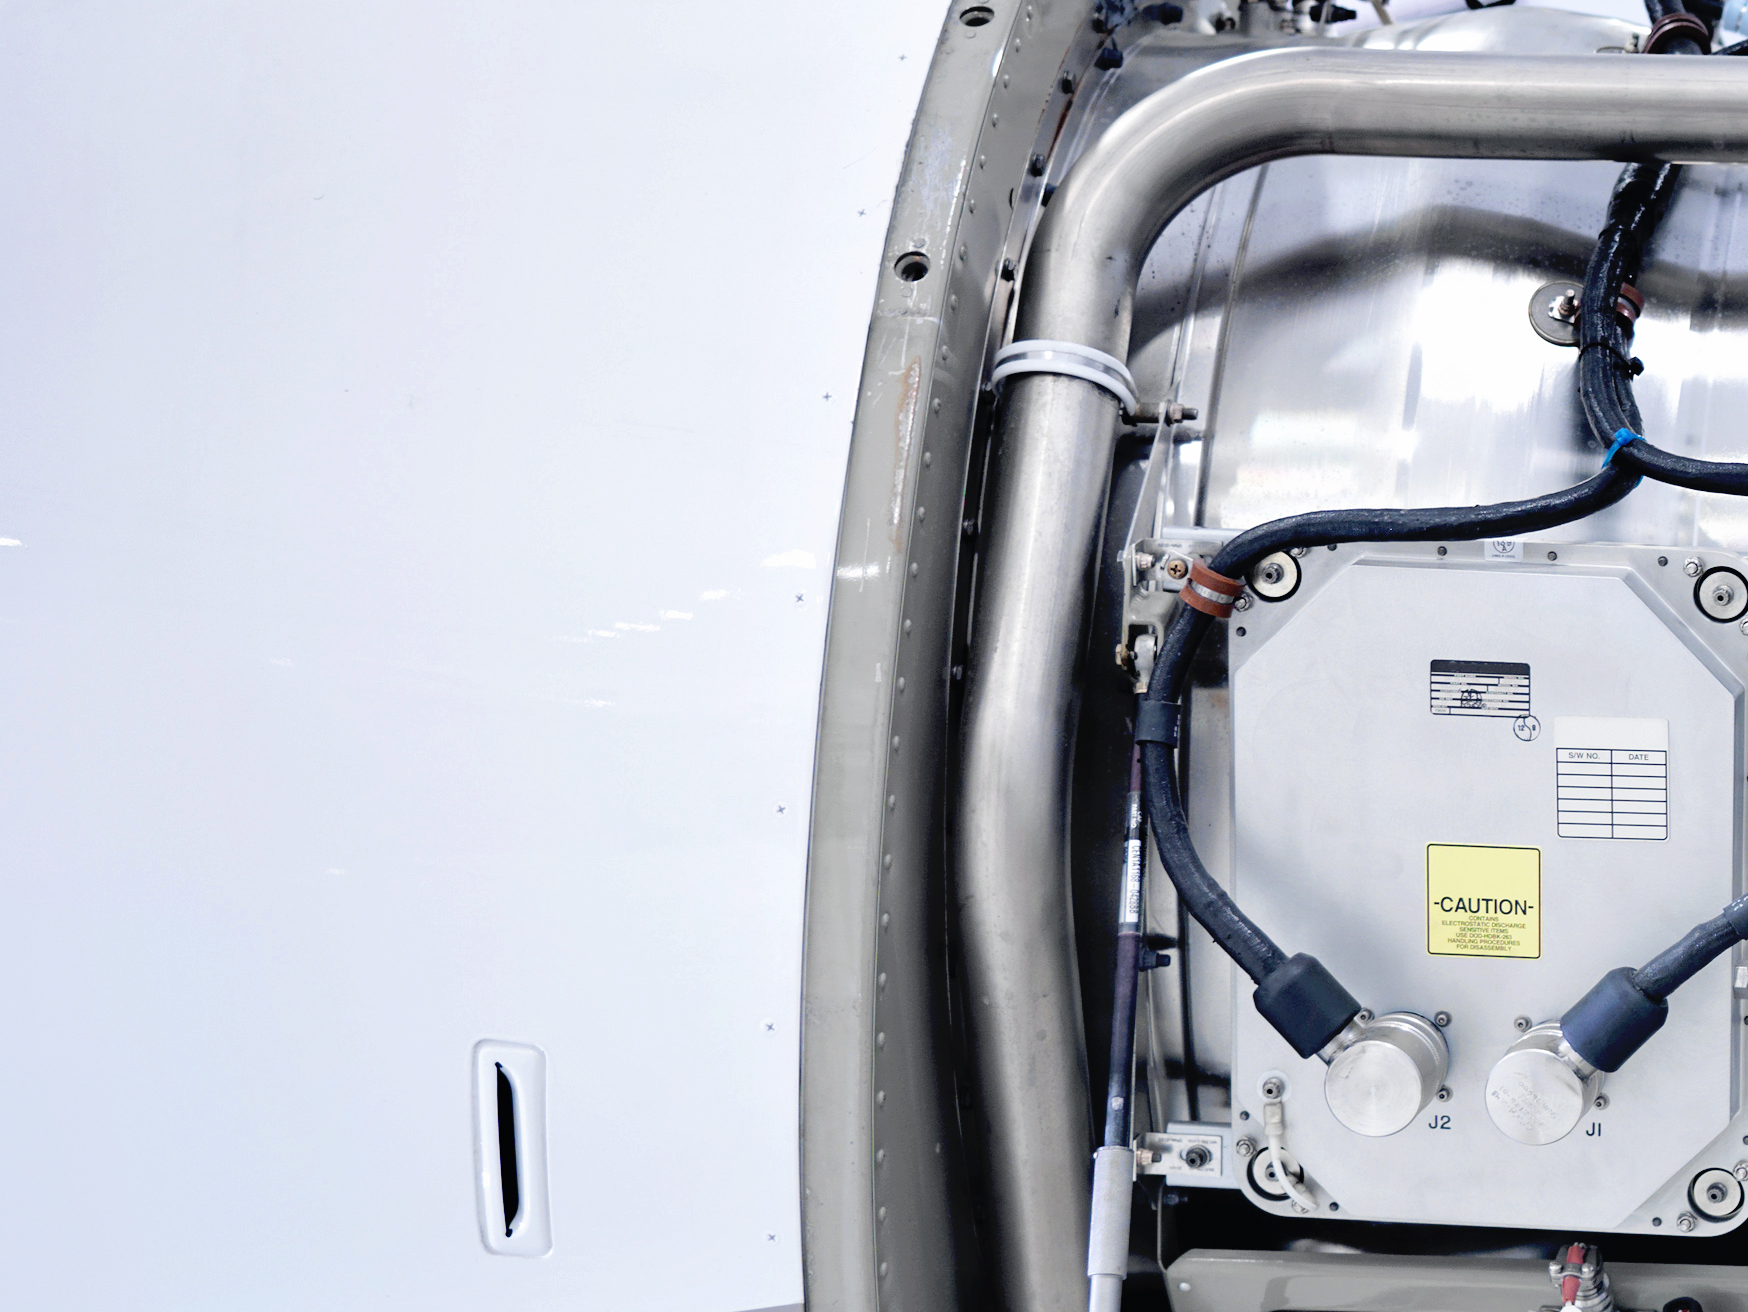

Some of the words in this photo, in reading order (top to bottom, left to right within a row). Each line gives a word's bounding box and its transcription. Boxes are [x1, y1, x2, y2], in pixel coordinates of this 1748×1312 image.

[1568, 751, 1584, 759] S/W
[1586, 752, 1600, 760] NO.
[1628, 753, 1649, 761] DATE
[1428, 1115, 1451, 1130] J2
[1586, 1122, 1602, 1137] J1
